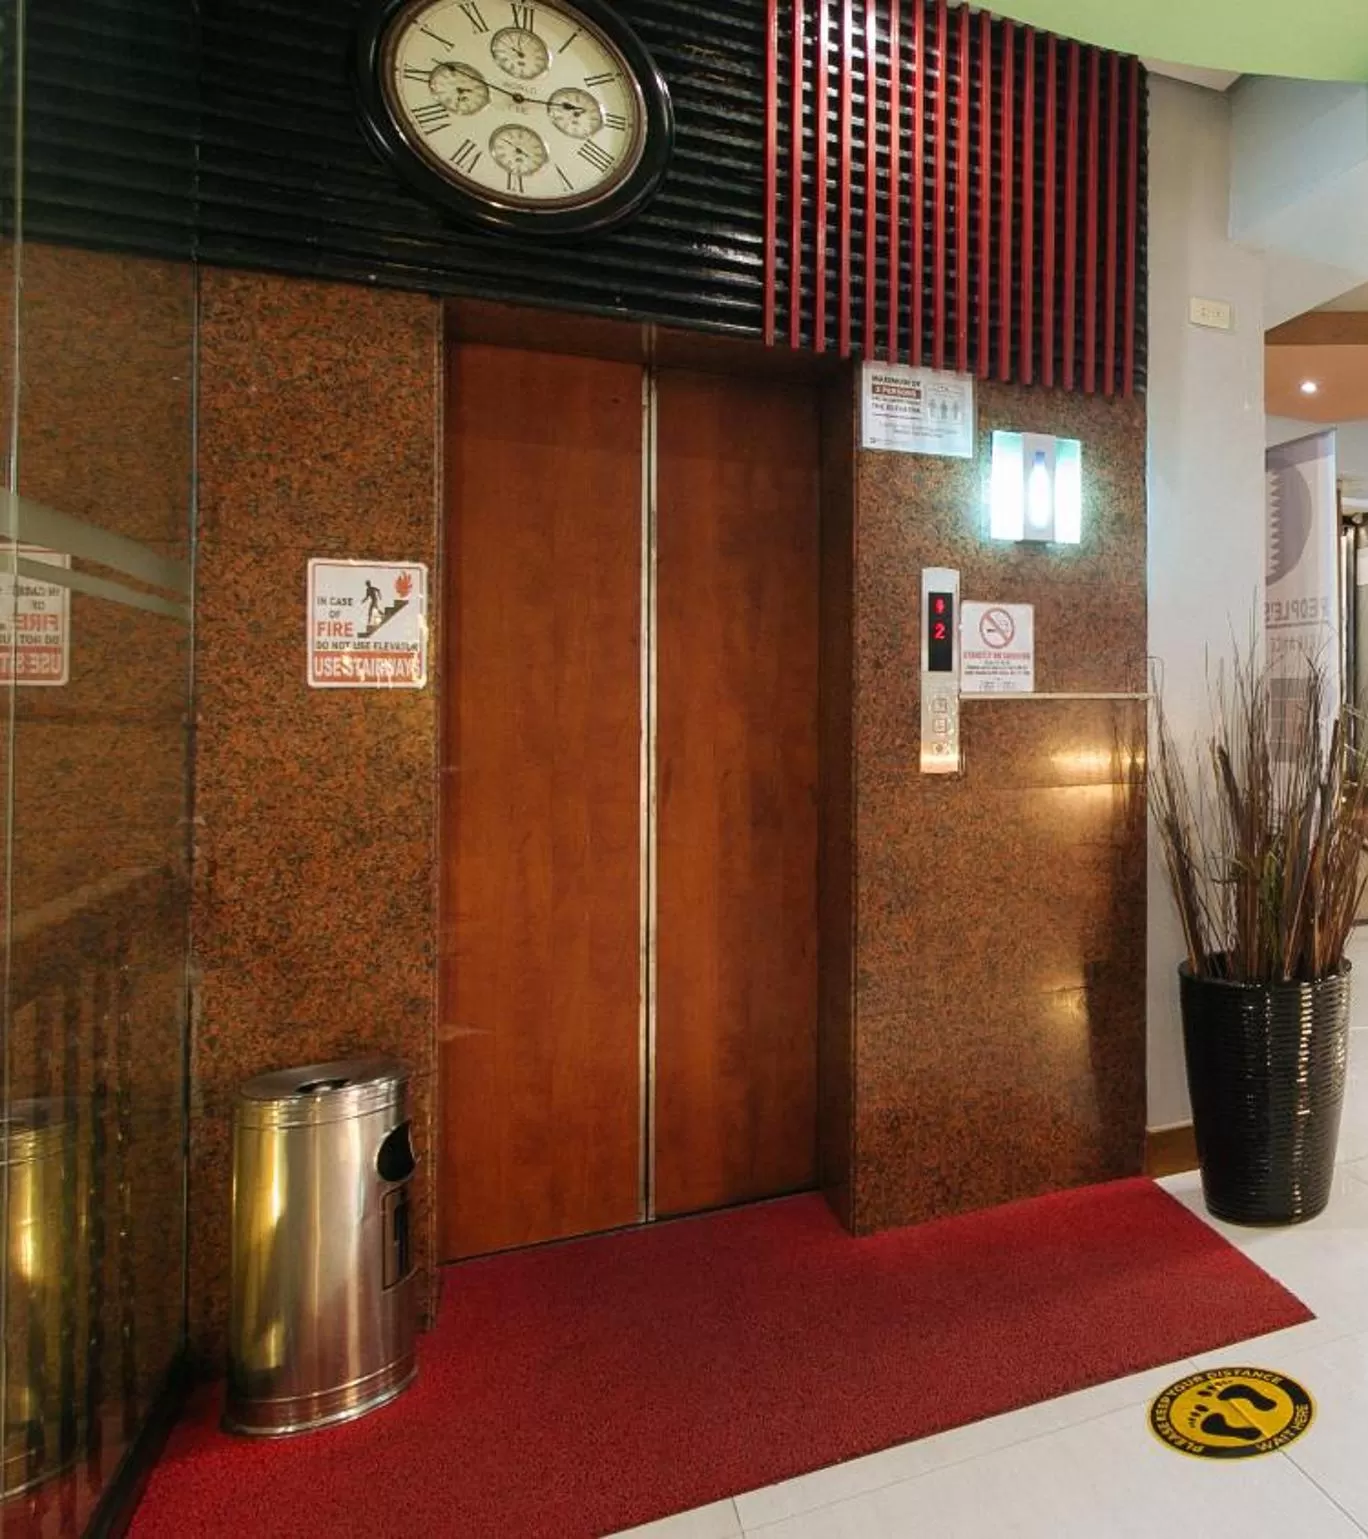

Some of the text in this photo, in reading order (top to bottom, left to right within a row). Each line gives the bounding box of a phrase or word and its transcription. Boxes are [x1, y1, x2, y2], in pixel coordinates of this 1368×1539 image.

[510, 3, 534, 33] XII
[317, 597, 353, 606] IN CASE
[329, 610, 342, 618] OF
[317, 621, 354, 637] FIRE
[934, 622, 946, 640] 2
[316, 641, 328, 649] DO
[331, 641, 352, 650] NOT
[1165, 1375, 1204, 1396] YOUR
[1206, 1369, 1283, 1385] DISTANCE
